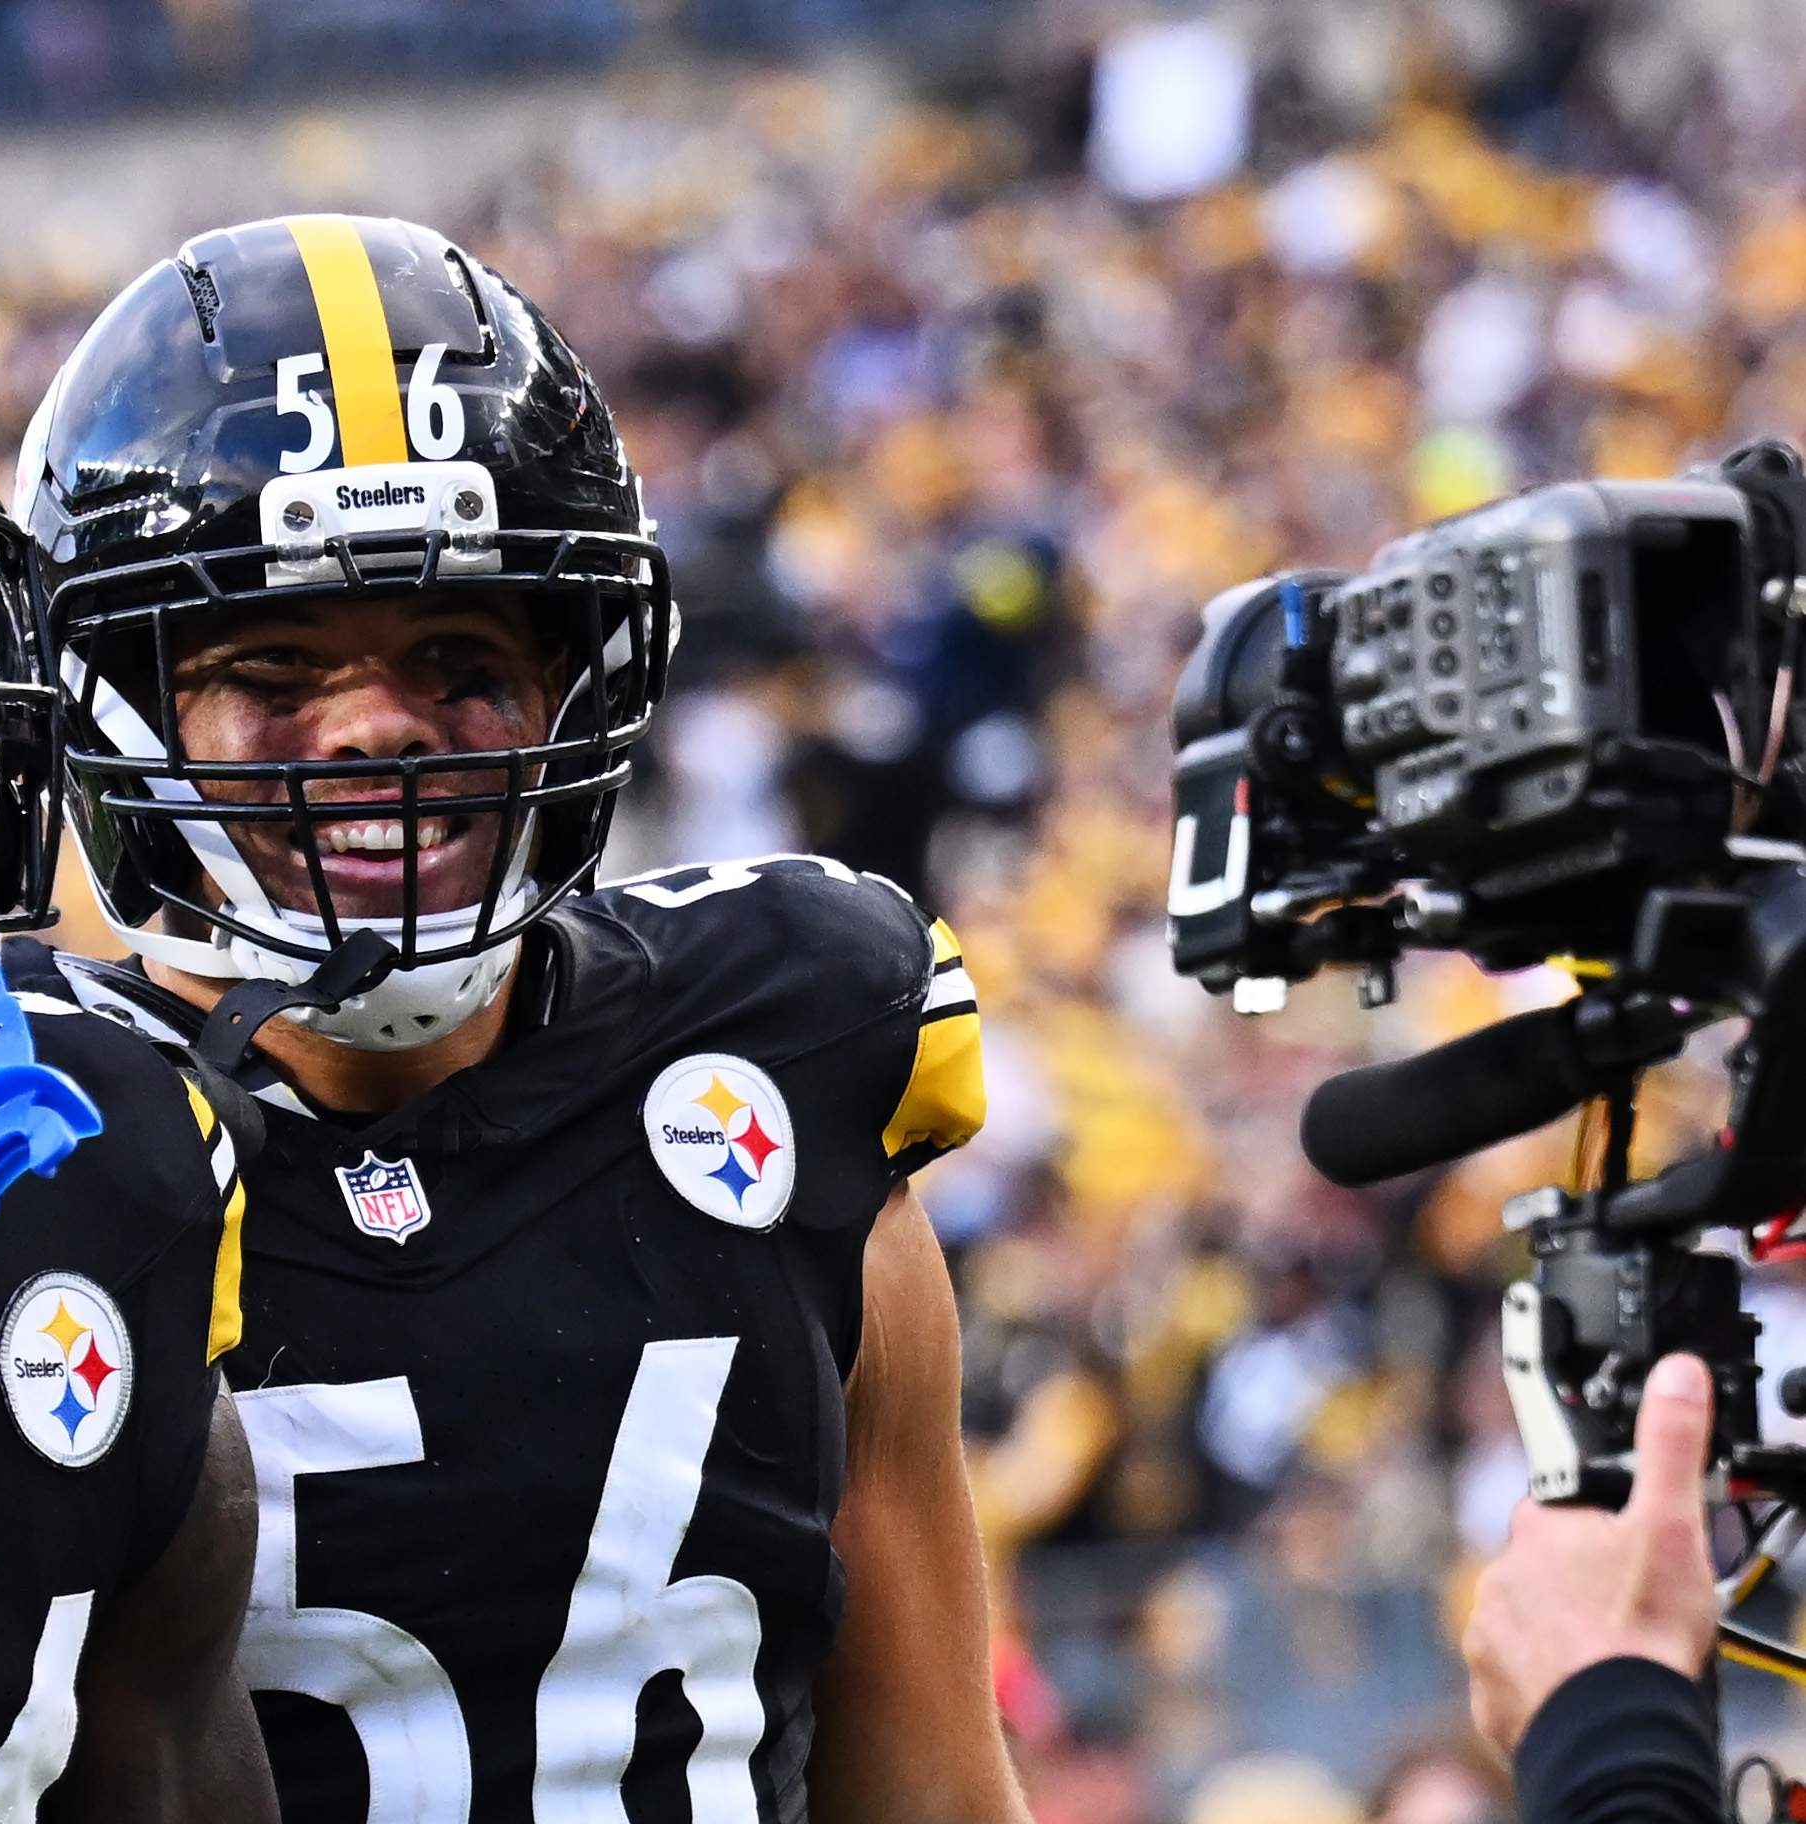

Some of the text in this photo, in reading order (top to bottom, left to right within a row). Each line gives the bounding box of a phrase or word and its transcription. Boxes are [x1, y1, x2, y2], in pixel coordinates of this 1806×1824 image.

[276, 342, 465, 473] 56
[336, 481, 425, 510] Steelers
[663, 1124, 725, 1146] Steelers
[359, 1192, 415, 1226] NFL
[14, 1356, 65, 1379] Steelers
